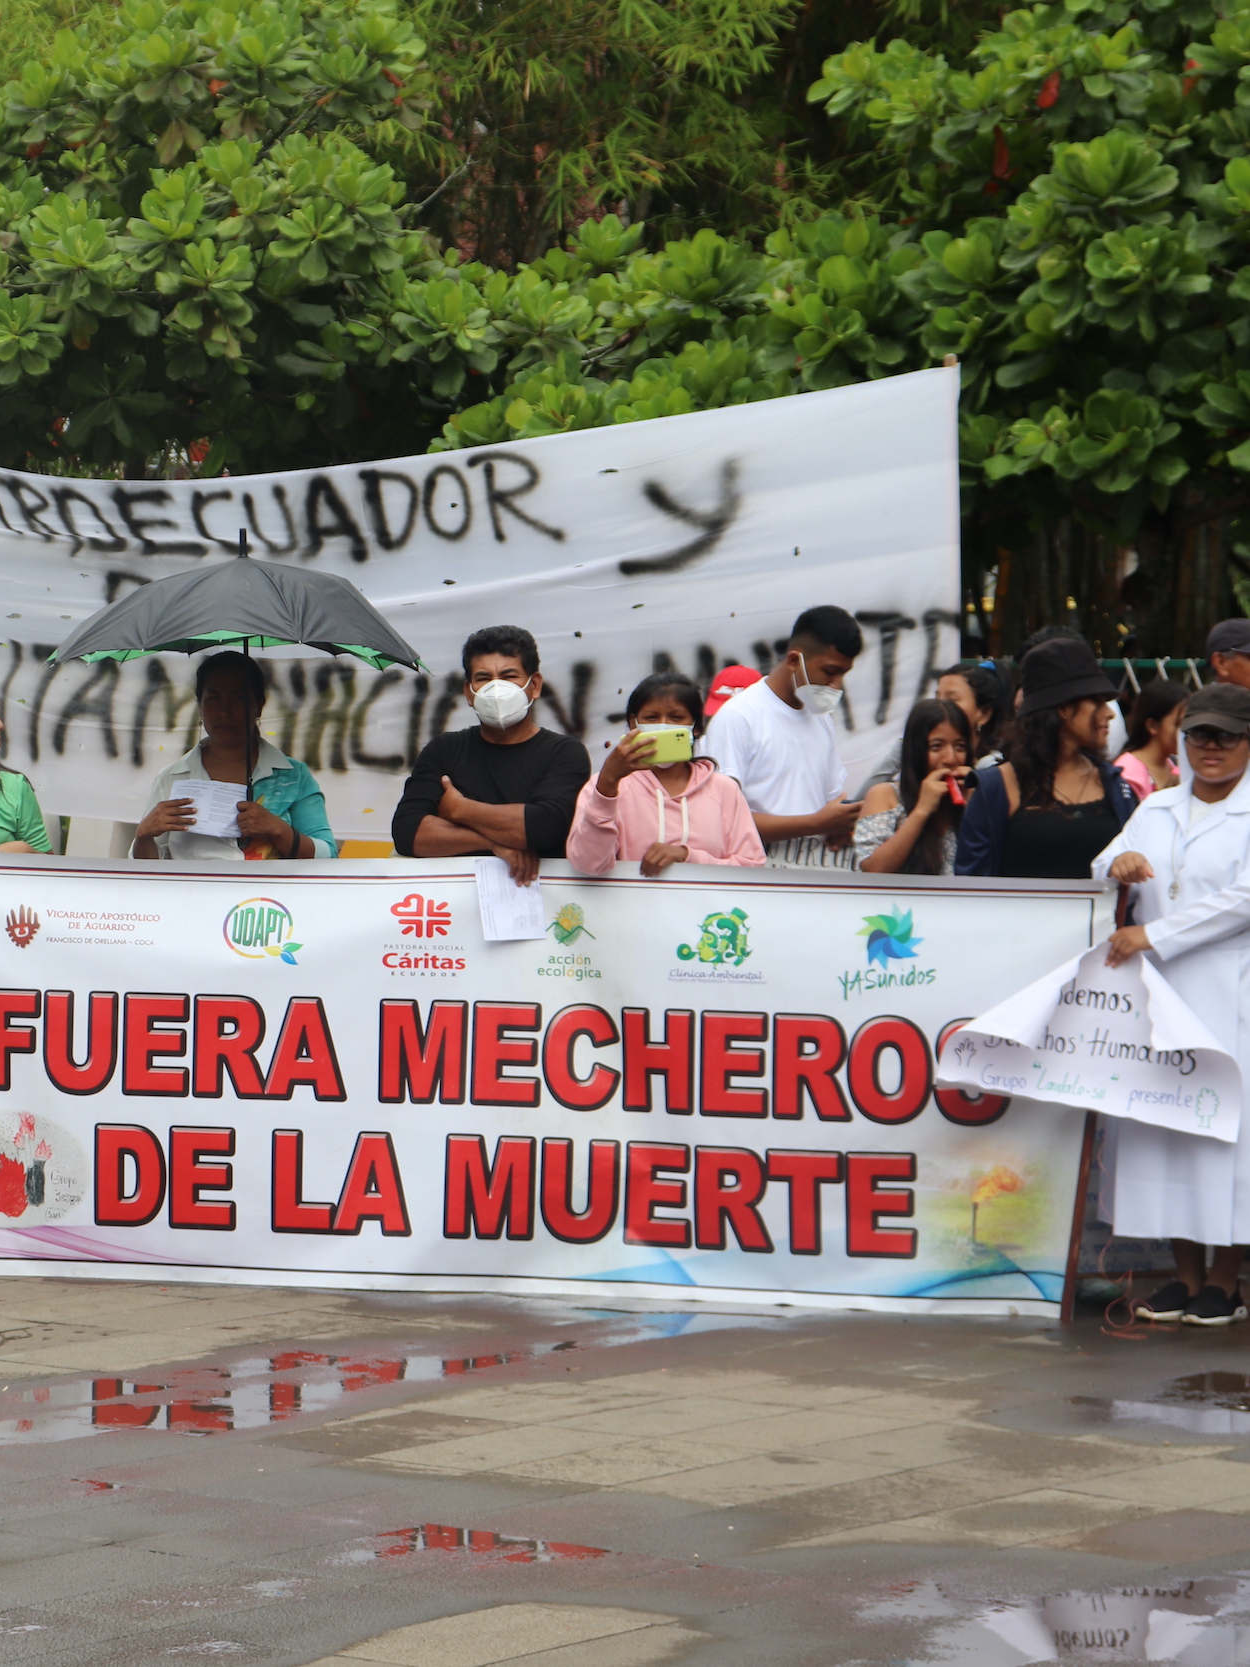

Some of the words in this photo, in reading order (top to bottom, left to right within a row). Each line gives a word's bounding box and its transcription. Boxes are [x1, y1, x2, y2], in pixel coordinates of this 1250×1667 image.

[68, 922, 81, 930] DE
[231, 903, 288, 948] UDAPT
[46, 936, 83, 944] FRANCISCO
[383, 943, 429, 951] PASTORAL
[381, 952, 467, 970] Cáritas
[548, 953, 592, 965] acción
[537, 965, 602, 981] ecológica
[980, 1063, 1028, 1091] Grupo
[1127, 1084, 1194, 1111] presente
[51, 1169, 77, 1188] Grupo
[94, 1123, 237, 1231] DE
[271, 1128, 412, 1237] LA
[442, 1132, 918, 1259] MUERTE
